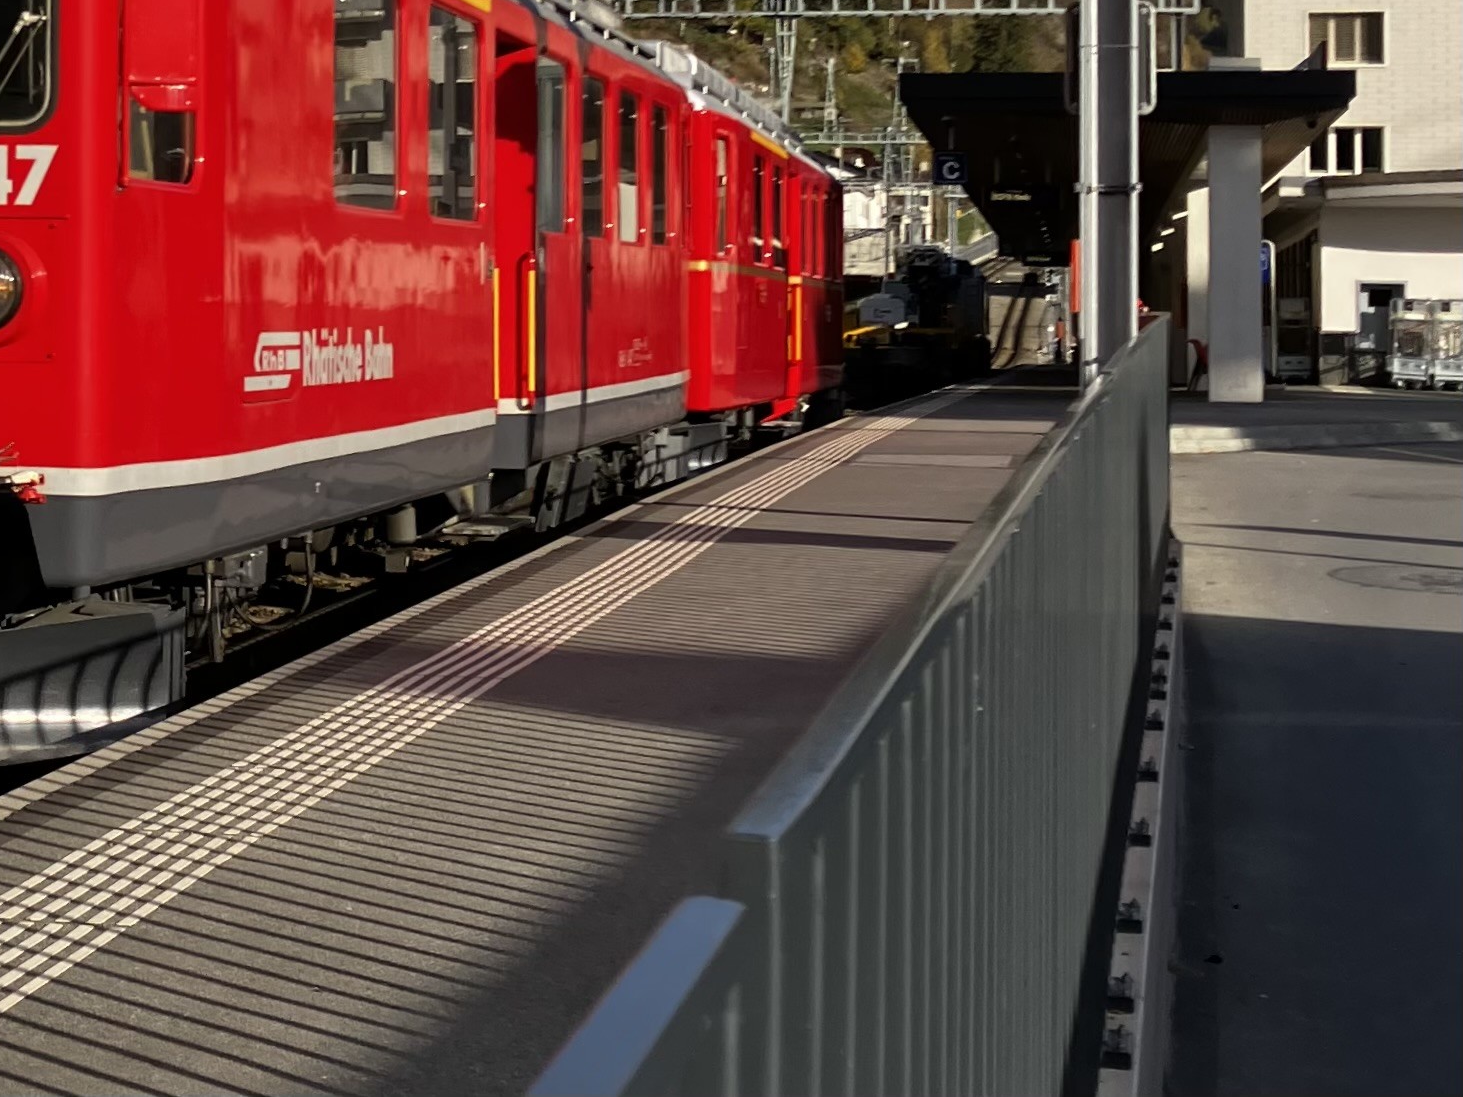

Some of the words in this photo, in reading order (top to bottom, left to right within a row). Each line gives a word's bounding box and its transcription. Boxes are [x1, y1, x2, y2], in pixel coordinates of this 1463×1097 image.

[942, 162, 960, 179] C
[262, 350, 285, 370] RhB
[302, 327, 362, 387] Rhätische
[365, 326, 393, 380] Bahn
